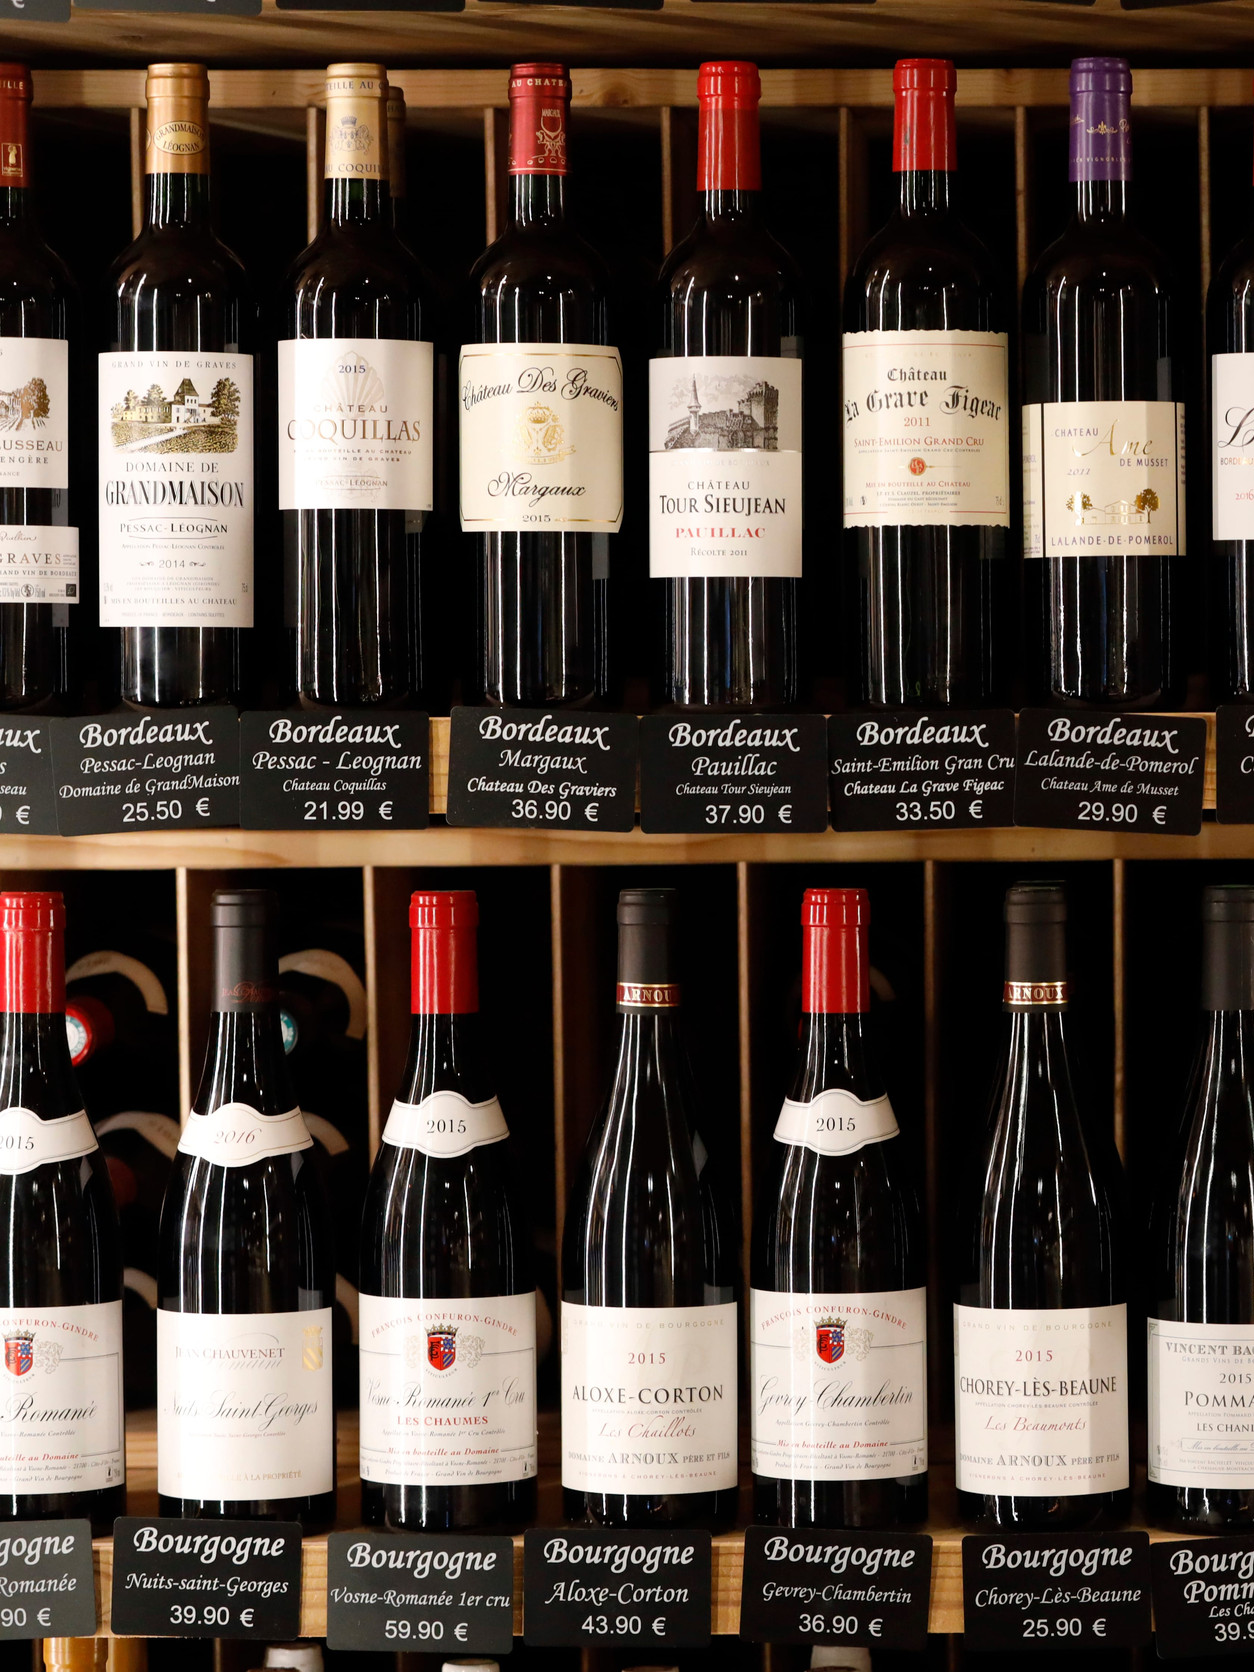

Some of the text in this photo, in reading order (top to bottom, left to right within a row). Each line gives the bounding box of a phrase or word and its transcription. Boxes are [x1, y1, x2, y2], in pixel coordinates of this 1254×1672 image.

[197, 361, 236, 369] GRAVES
[339, 365, 365, 374] 2015
[1055, 428, 1098, 437] CHATEAU
[126, 462, 219, 473] DOMAINE DE
[1120, 458, 1168, 467] DE MUSSET
[106, 481, 243, 506] GRANDMAISON
[688, 480, 749, 490] CHÂTEAU
[660, 494, 785, 516] TOUR SIEUJEAN
[121, 523, 227, 533] PESSAC-LÉOGNAN
[676, 528, 765, 538] PAUILLAC
[159, 560, 185, 568] 2014
[80, 716, 212, 748] Bordeaux
[479, 715, 610, 750] Bordeaux
[857, 717, 989, 747] Bordeaux
[80, 753, 215, 773] Pessac-Leognan
[499, 750, 587, 774] Margaux
[832, 755, 1014, 774] Saint-Emilion Gran Cru
[59, 774, 239, 798] Domaine de GrandMaison
[468, 777, 616, 799] Chateau Des Graviers
[845, 780, 1004, 796] Chateau La Grave Figeac
[123, 798, 210, 822] 25.50 €
[512, 799, 598, 821] 36.90 €
[896, 800, 982, 820] 33.50 €
[427, 1119, 466, 1133] 2015
[629, 1353, 665, 1364] 2015
[1016, 1350, 1052, 1362] 2015
[574, 1385, 722, 1404] ALOXE-CORTON
[960, 1377, 1116, 1396] CHOREY-LÈS-BEAUNE
[599, 1415, 696, 1438] Les Chaillots
[984, 1416, 1085, 1431] Les Beaumonts
[134, 1527, 284, 1564] Bourgogne
[347, 1543, 496, 1579] Bourgogne
[765, 1537, 915, 1575] Bourgogne
[125, 1573, 288, 1598] Nuits-saint-Georges
[763, 1582, 911, 1603] Gevrey-Chambertin
[331, 1587, 509, 1607] Vosne-Romanée 1er cru
[170, 1605, 254, 1627] 39.90 €
[1209, 1606, 1230, 1617] Les
[385, 1621, 468, 1641] 59.90 €
[799, 1614, 882, 1636] 36.90 €
